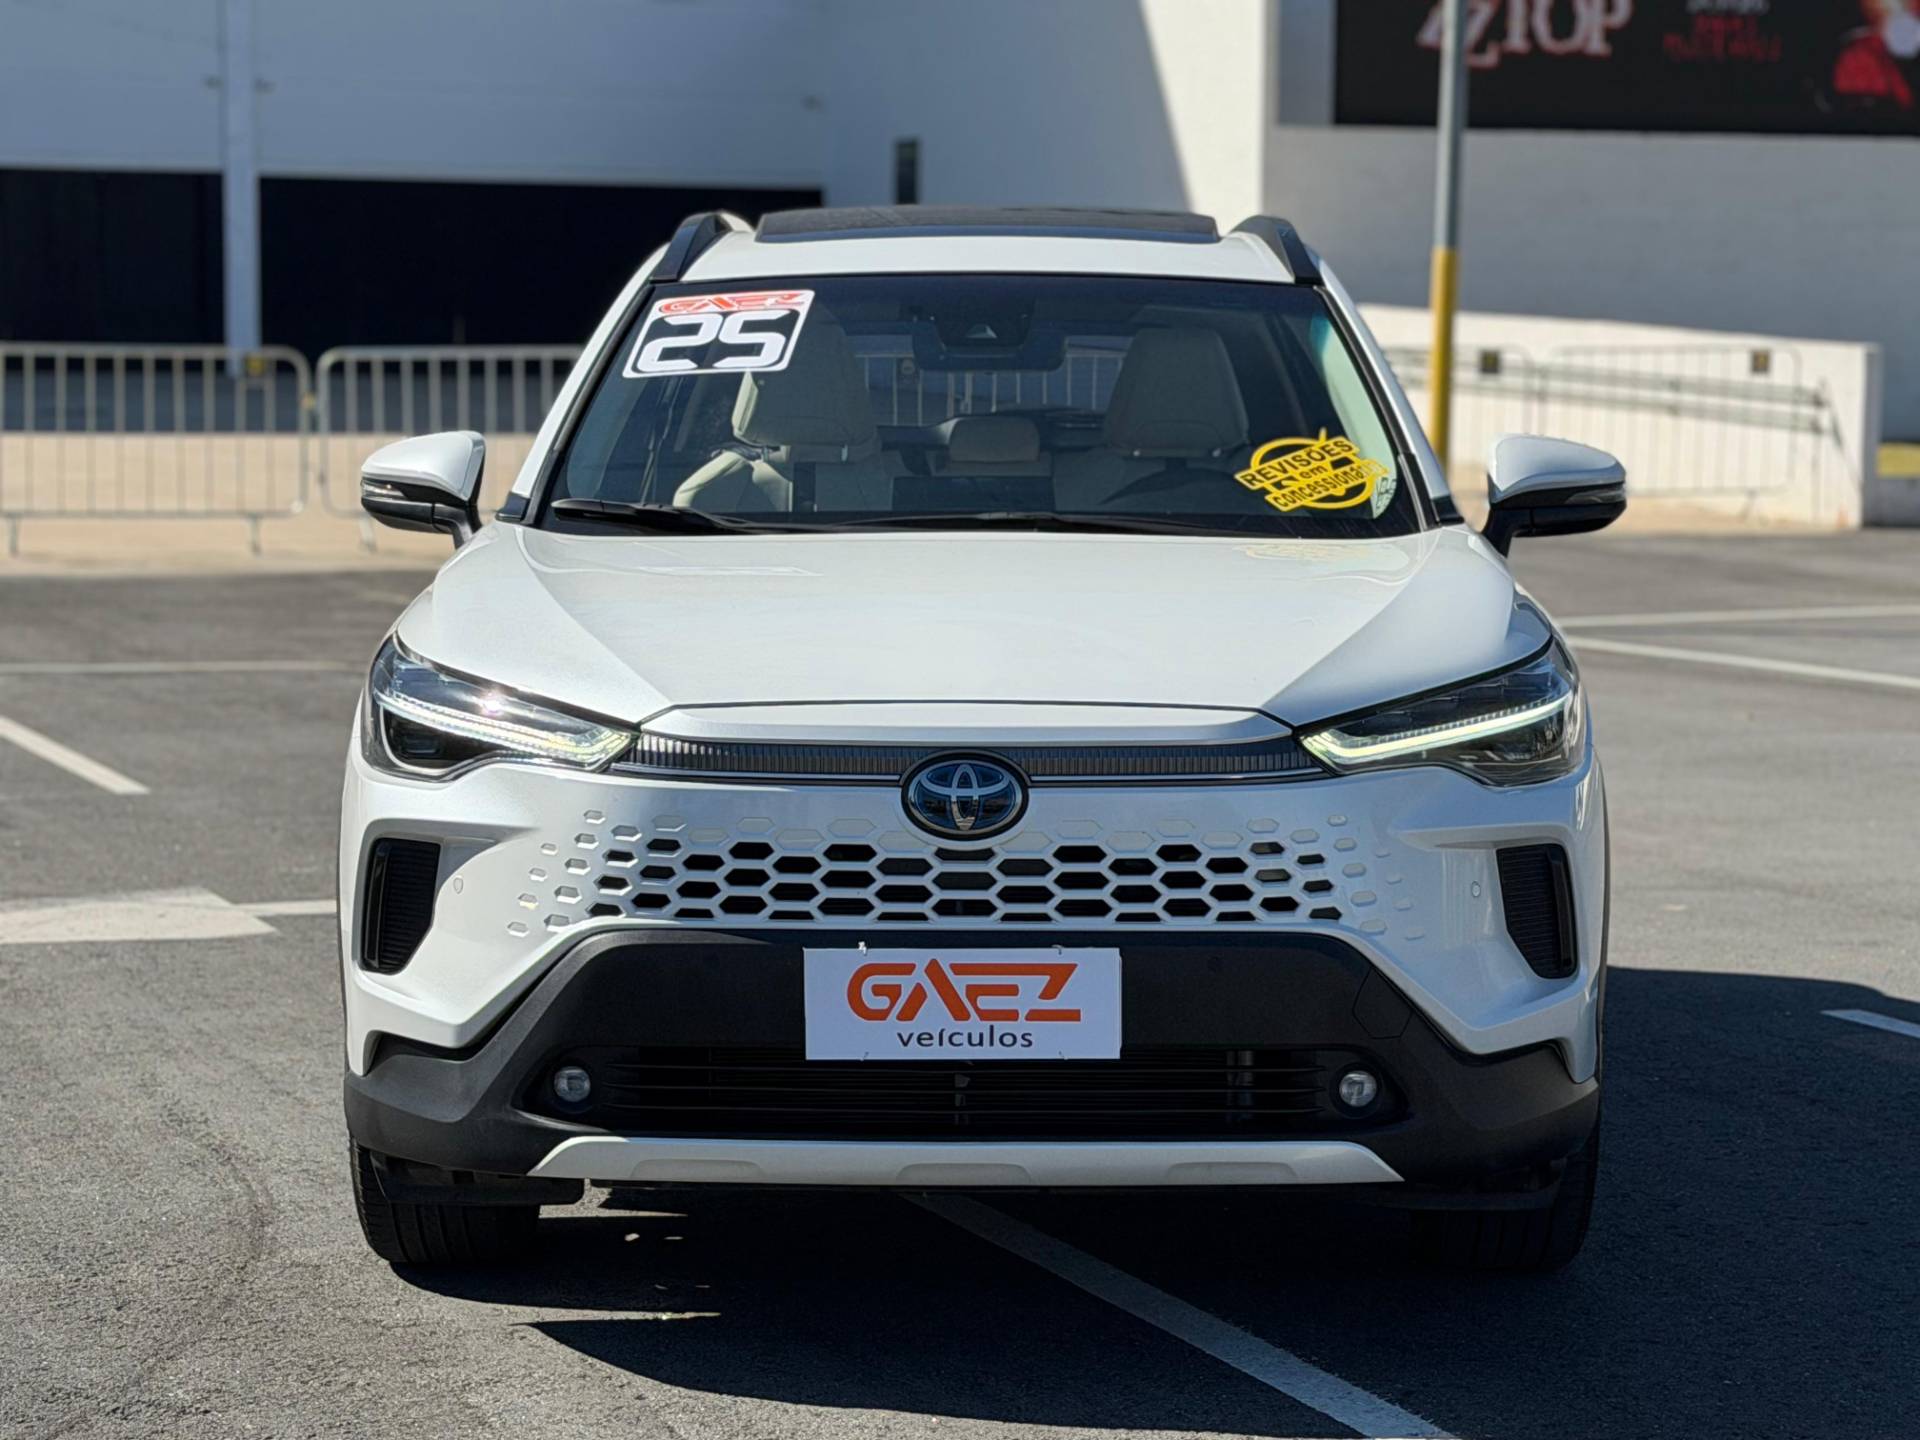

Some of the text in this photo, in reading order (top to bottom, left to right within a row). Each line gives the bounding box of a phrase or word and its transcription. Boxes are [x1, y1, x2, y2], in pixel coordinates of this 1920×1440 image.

[637, 310, 790, 373] 25
[1240, 439, 1354, 487] REVISÕES
[1273, 461, 1383, 508] concessioná
[1299, 465, 1330, 480] em
[847, 958, 1081, 1021] GAEZ
[896, 1025, 1033, 1048] veículos
